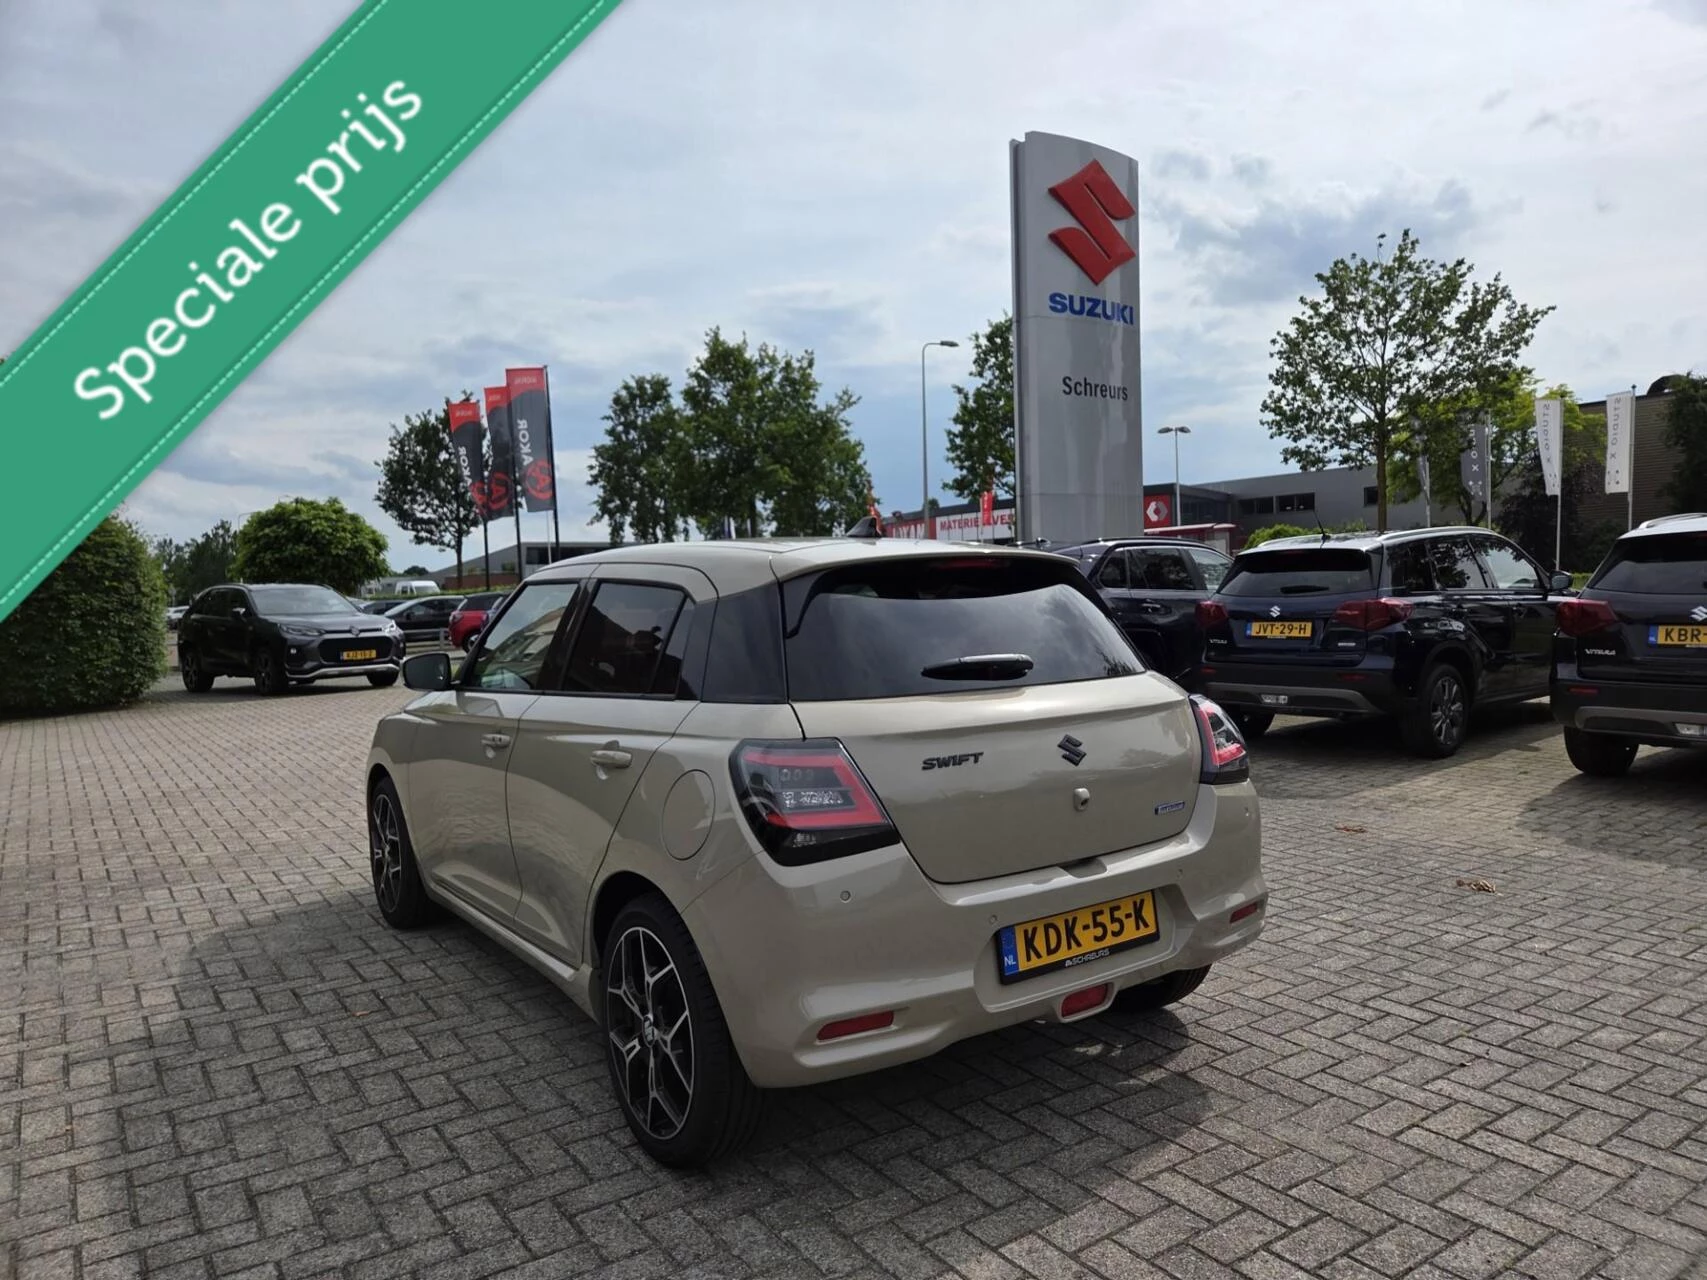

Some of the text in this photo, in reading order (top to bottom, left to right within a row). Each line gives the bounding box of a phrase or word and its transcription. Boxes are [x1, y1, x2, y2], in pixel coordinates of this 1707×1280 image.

[1048, 292, 1134, 325] SUZUKI
[1061, 376, 1128, 401] Schreurs
[1255, 624, 1307, 635] JVT-29-H
[921, 752, 984, 771] SWIFT
[1004, 898, 1150, 966] NL KDK-55-K
